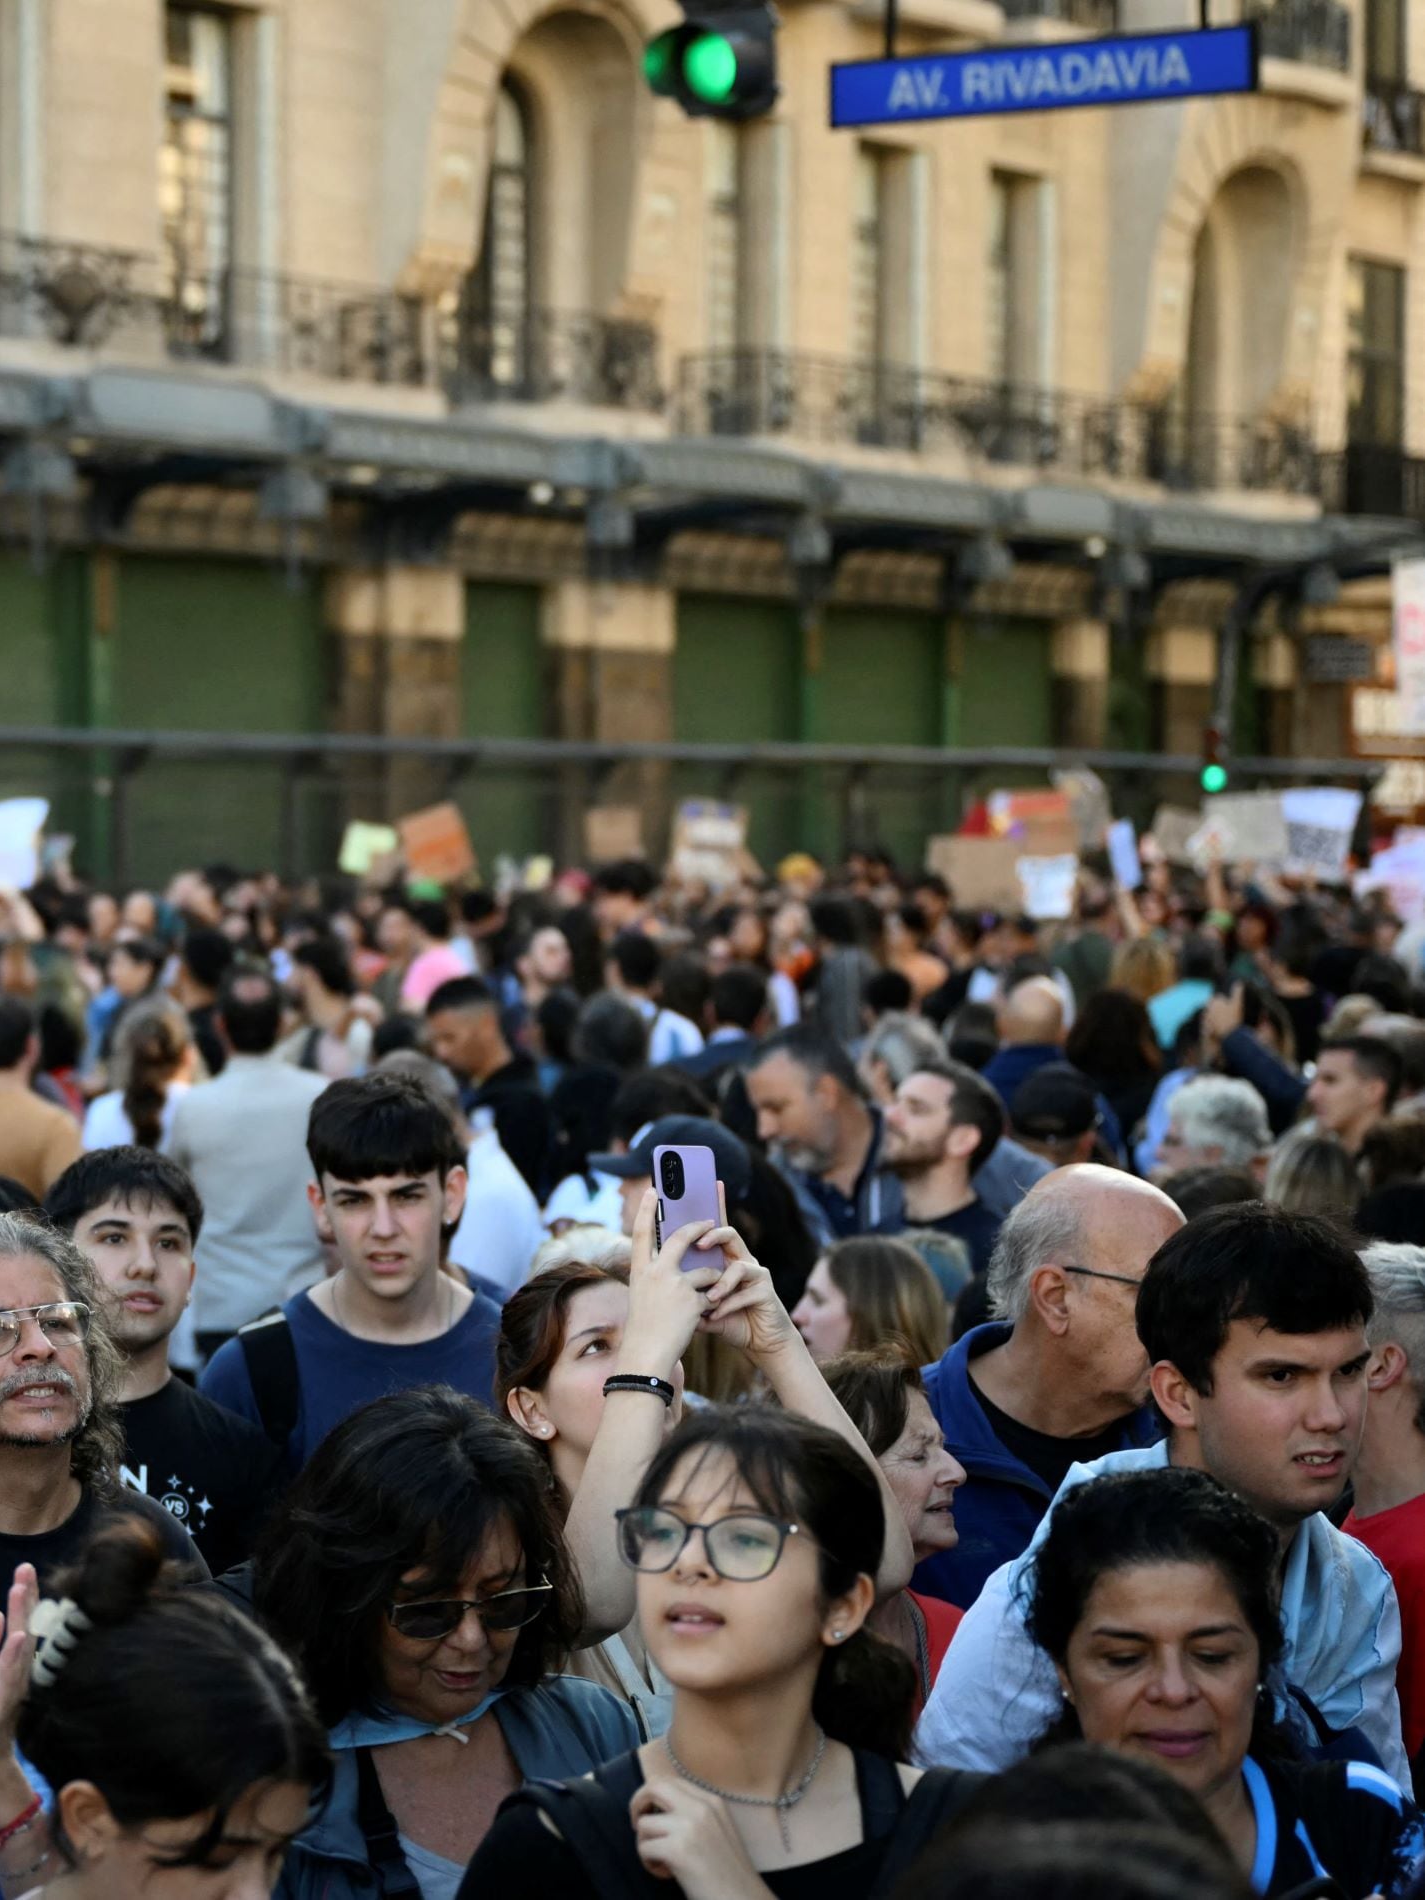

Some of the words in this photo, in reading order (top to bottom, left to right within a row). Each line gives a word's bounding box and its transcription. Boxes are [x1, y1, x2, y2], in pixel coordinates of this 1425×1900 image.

[888, 66, 950, 111] AV.
[960, 45, 1192, 107] RIVADAVIA
[164, 1499, 184, 1515] VS
